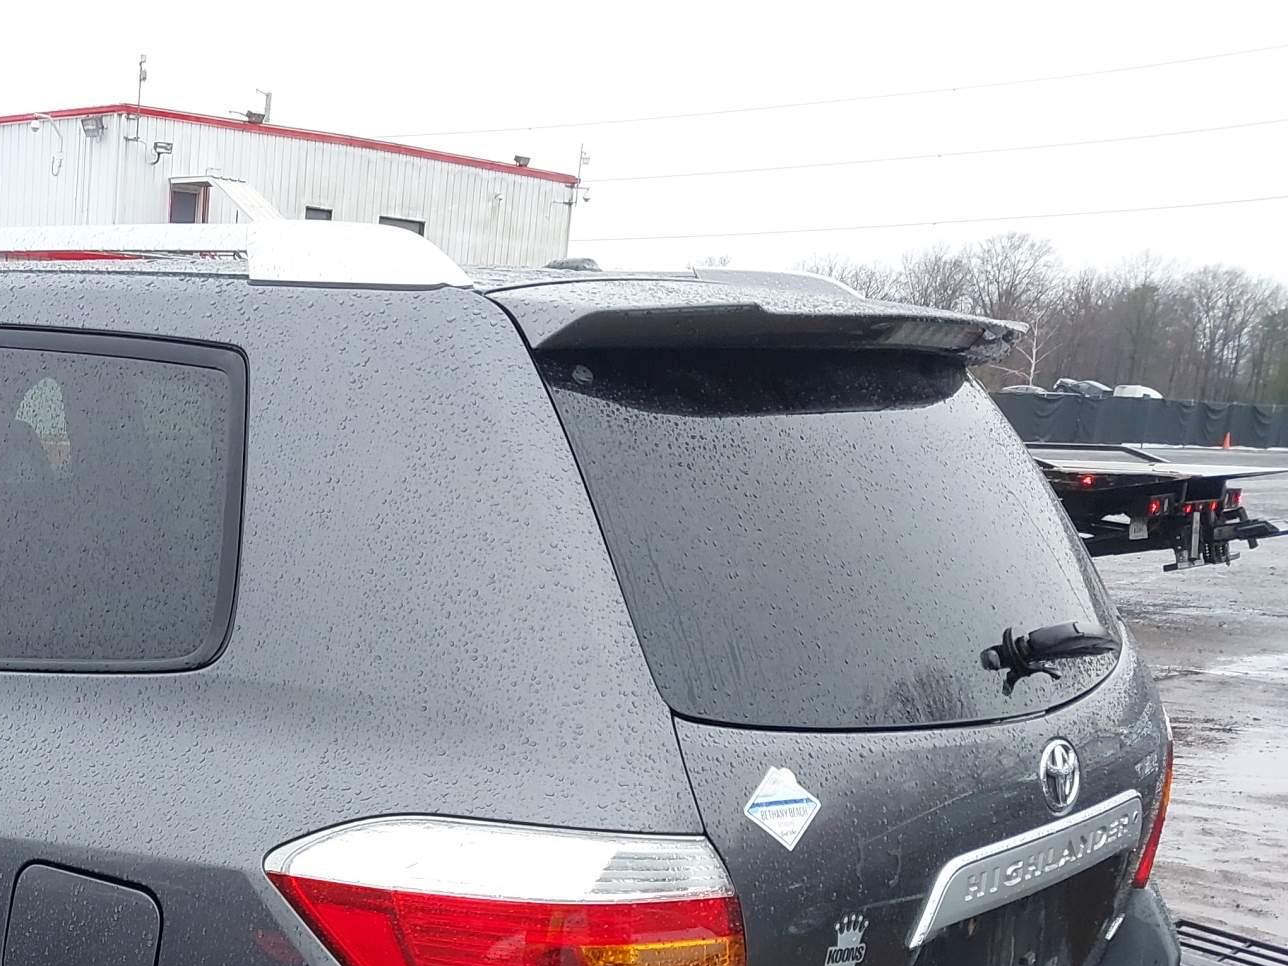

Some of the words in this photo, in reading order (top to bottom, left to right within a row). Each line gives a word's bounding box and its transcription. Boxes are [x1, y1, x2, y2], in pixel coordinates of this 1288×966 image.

[760, 809, 788, 821] BETHANY
[788, 806, 808, 818] BEACH
[964, 816, 1129, 901] HIGHLANDER
[827, 946, 864, 964] KOONS
